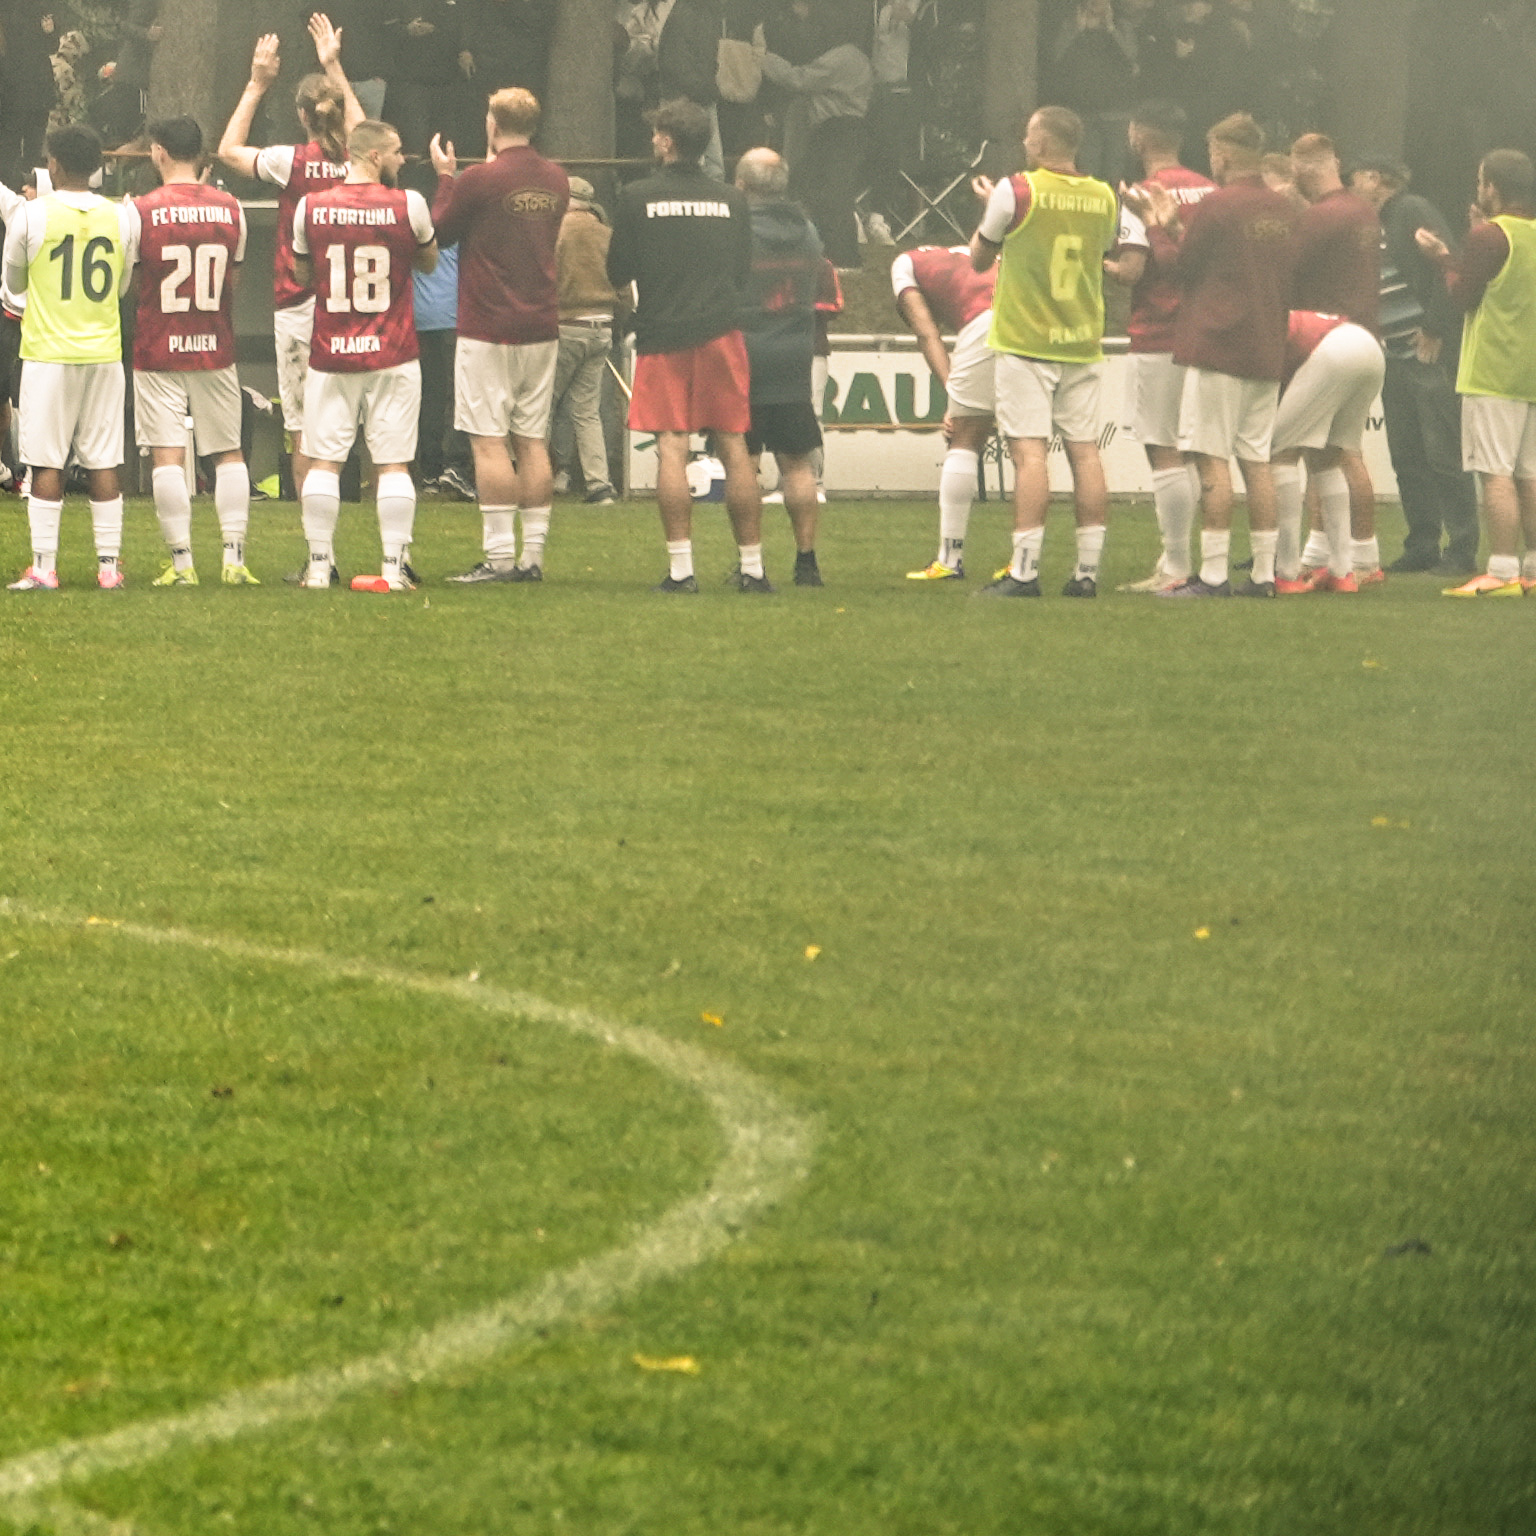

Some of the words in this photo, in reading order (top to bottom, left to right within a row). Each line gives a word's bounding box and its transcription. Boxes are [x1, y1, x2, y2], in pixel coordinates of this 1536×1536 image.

[305, 161, 321, 179] FC
[646, 201, 731, 218] FORTUNA
[1049, 193, 1108, 215] FORTUNA
[151, 208, 169, 226] FC
[170, 206, 233, 225] FORTUNA
[313, 207, 328, 225] FC
[329, 207, 397, 226] FORTUNA
[49, 234, 115, 302] 16
[1049, 234, 1083, 301] 6
[161, 243, 228, 313] 20
[325, 244, 391, 313] 18
[169, 334, 217, 353] PLAUEN
[330, 335, 381, 354] PLAUEN
